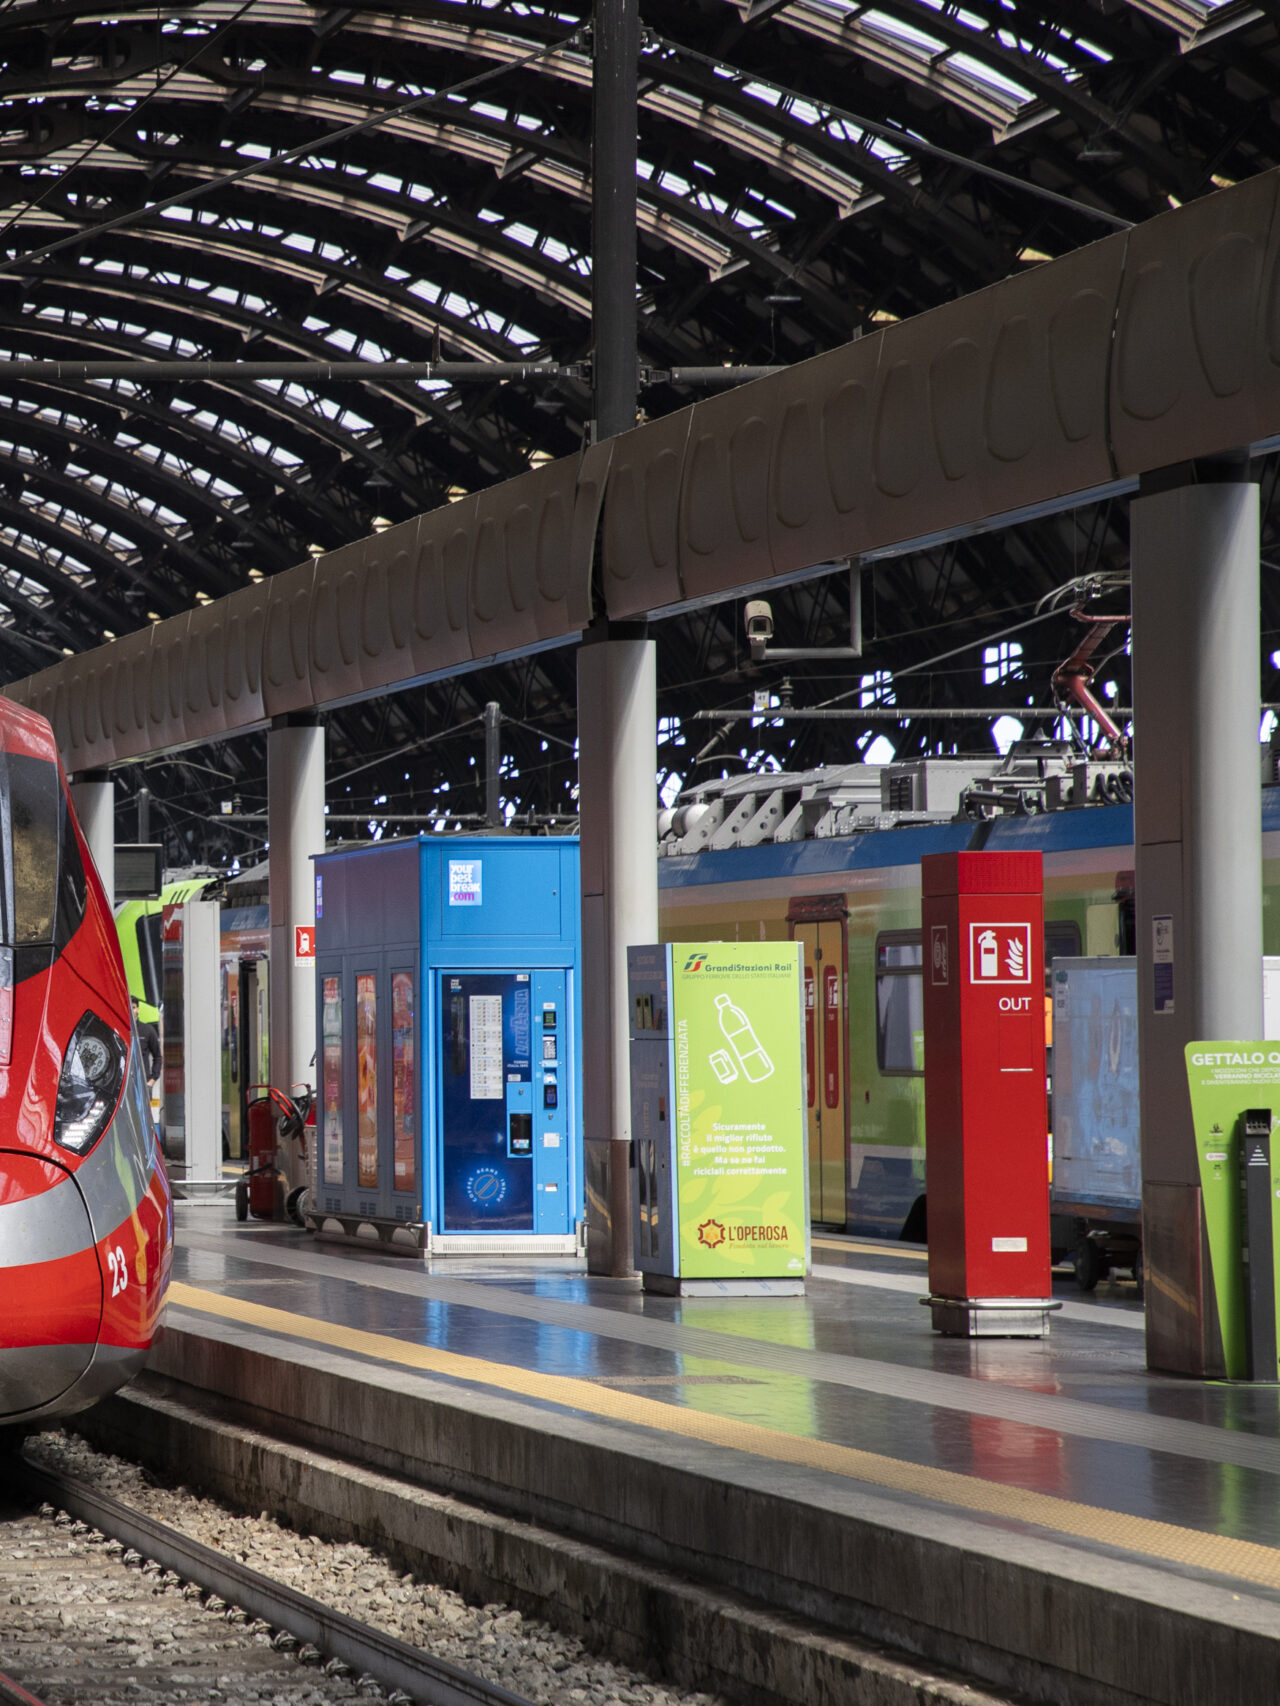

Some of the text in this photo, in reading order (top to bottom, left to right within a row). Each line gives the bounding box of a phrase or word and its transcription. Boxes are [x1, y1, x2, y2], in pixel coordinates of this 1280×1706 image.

[450, 864, 474, 875] your
[450, 872, 472, 883] best
[450, 882, 481, 892] break
[705, 963, 792, 972] GrandiStazioni Rail
[999, 997, 1032, 1011] OUT
[1191, 1052, 1265, 1066] GETTALO
[712, 1123, 766, 1131] Sicuramente
[714, 1134, 744, 1143] miglior
[745, 1133, 773, 1142] rifiuto
[700, 1145, 726, 1154] quello
[746, 1145, 786, 1154] prodotto.
[714, 1156, 728, 1164] Ma
[753, 1155, 765, 1163] fai
[726, 1167, 787, 1175] correttamente
[728, 1225, 789, 1241] L'OPEROSA
[108, 1245, 128, 1298] 23
